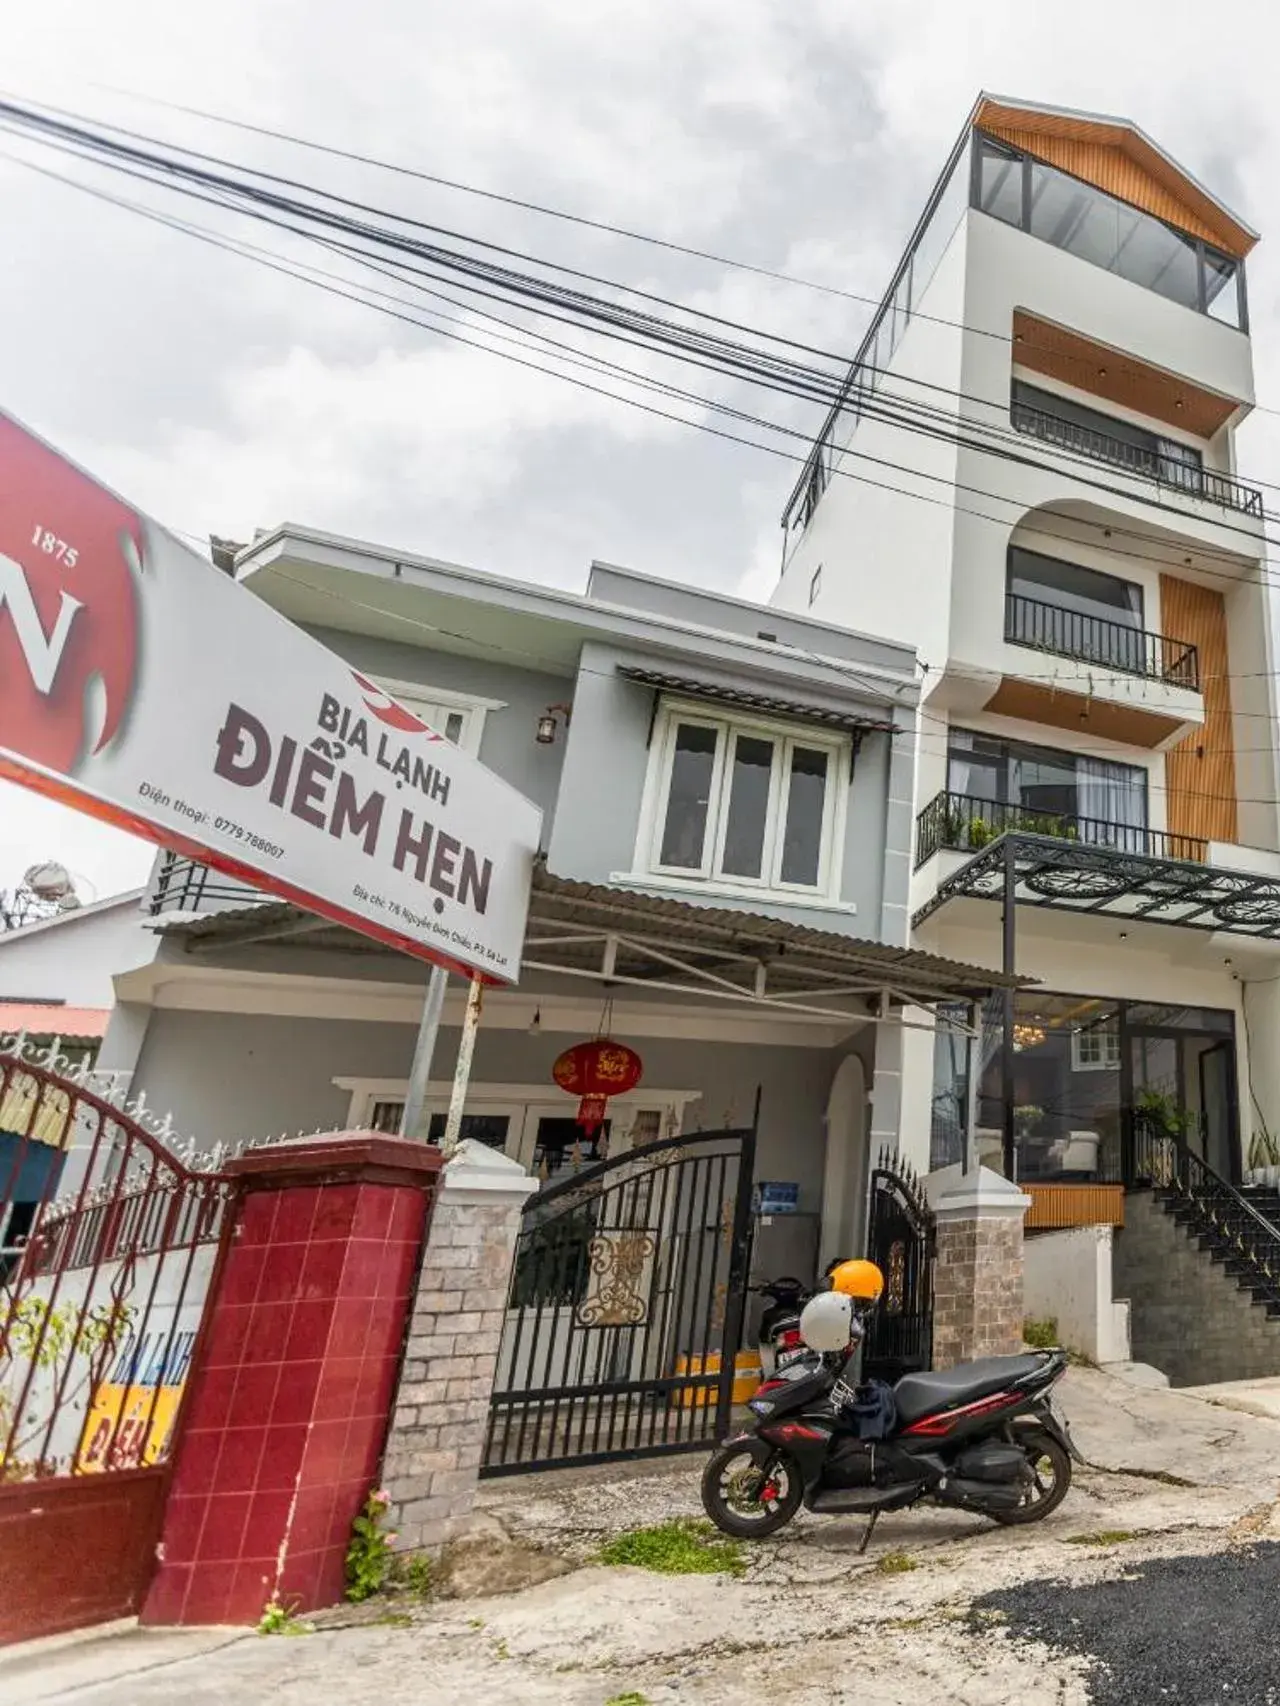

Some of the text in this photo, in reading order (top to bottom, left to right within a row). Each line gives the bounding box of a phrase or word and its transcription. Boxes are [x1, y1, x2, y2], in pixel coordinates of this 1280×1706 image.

[32, 525, 79, 568] 1875
[318, 692, 451, 807] BIA LẠNH
[138, 781, 170, 806] Điện
[214, 817, 244, 838] 0779
[213, 702, 493, 915] ĐIỂM HẸN
